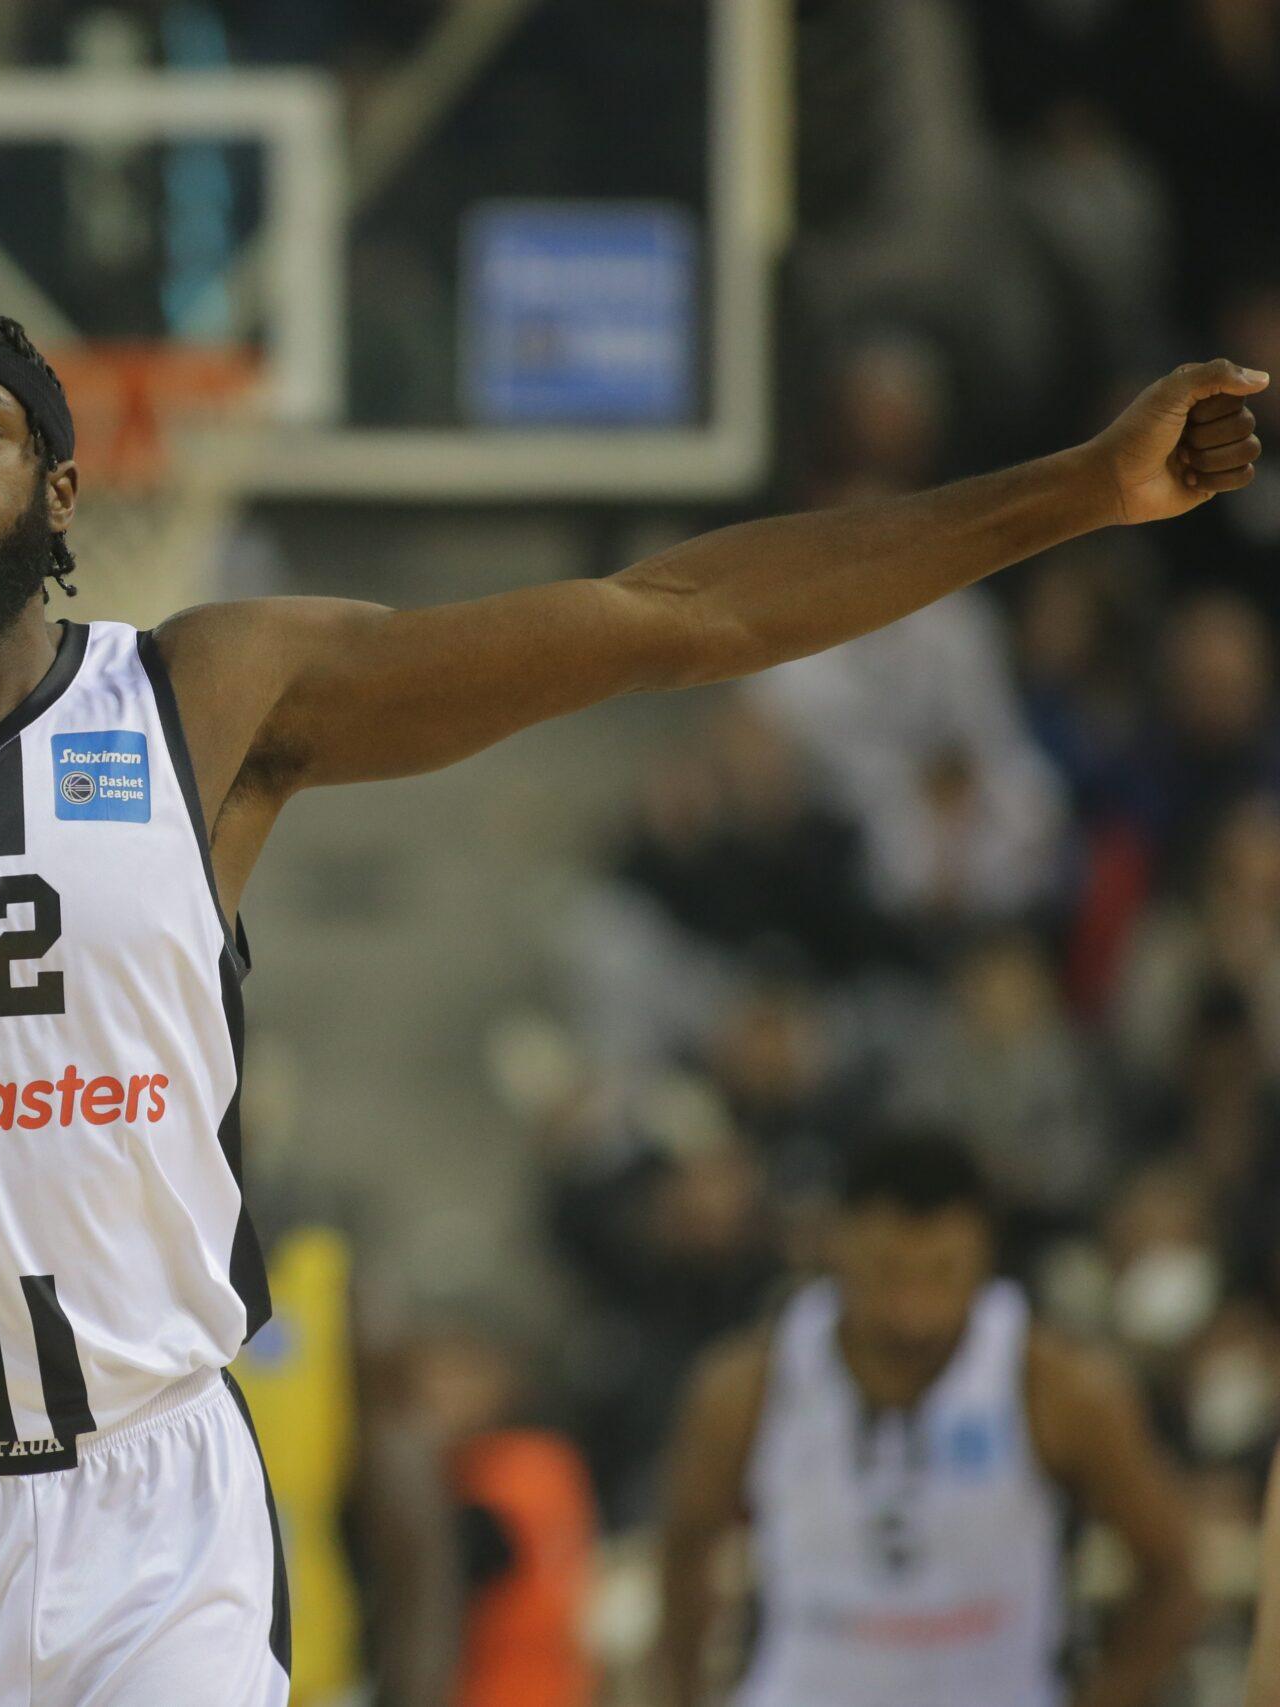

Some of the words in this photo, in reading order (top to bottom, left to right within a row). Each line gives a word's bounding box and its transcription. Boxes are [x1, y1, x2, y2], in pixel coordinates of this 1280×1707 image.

[60, 748, 141, 764] Stoiximan
[99, 775, 143, 788] Basket
[100, 787, 144, 801] League
